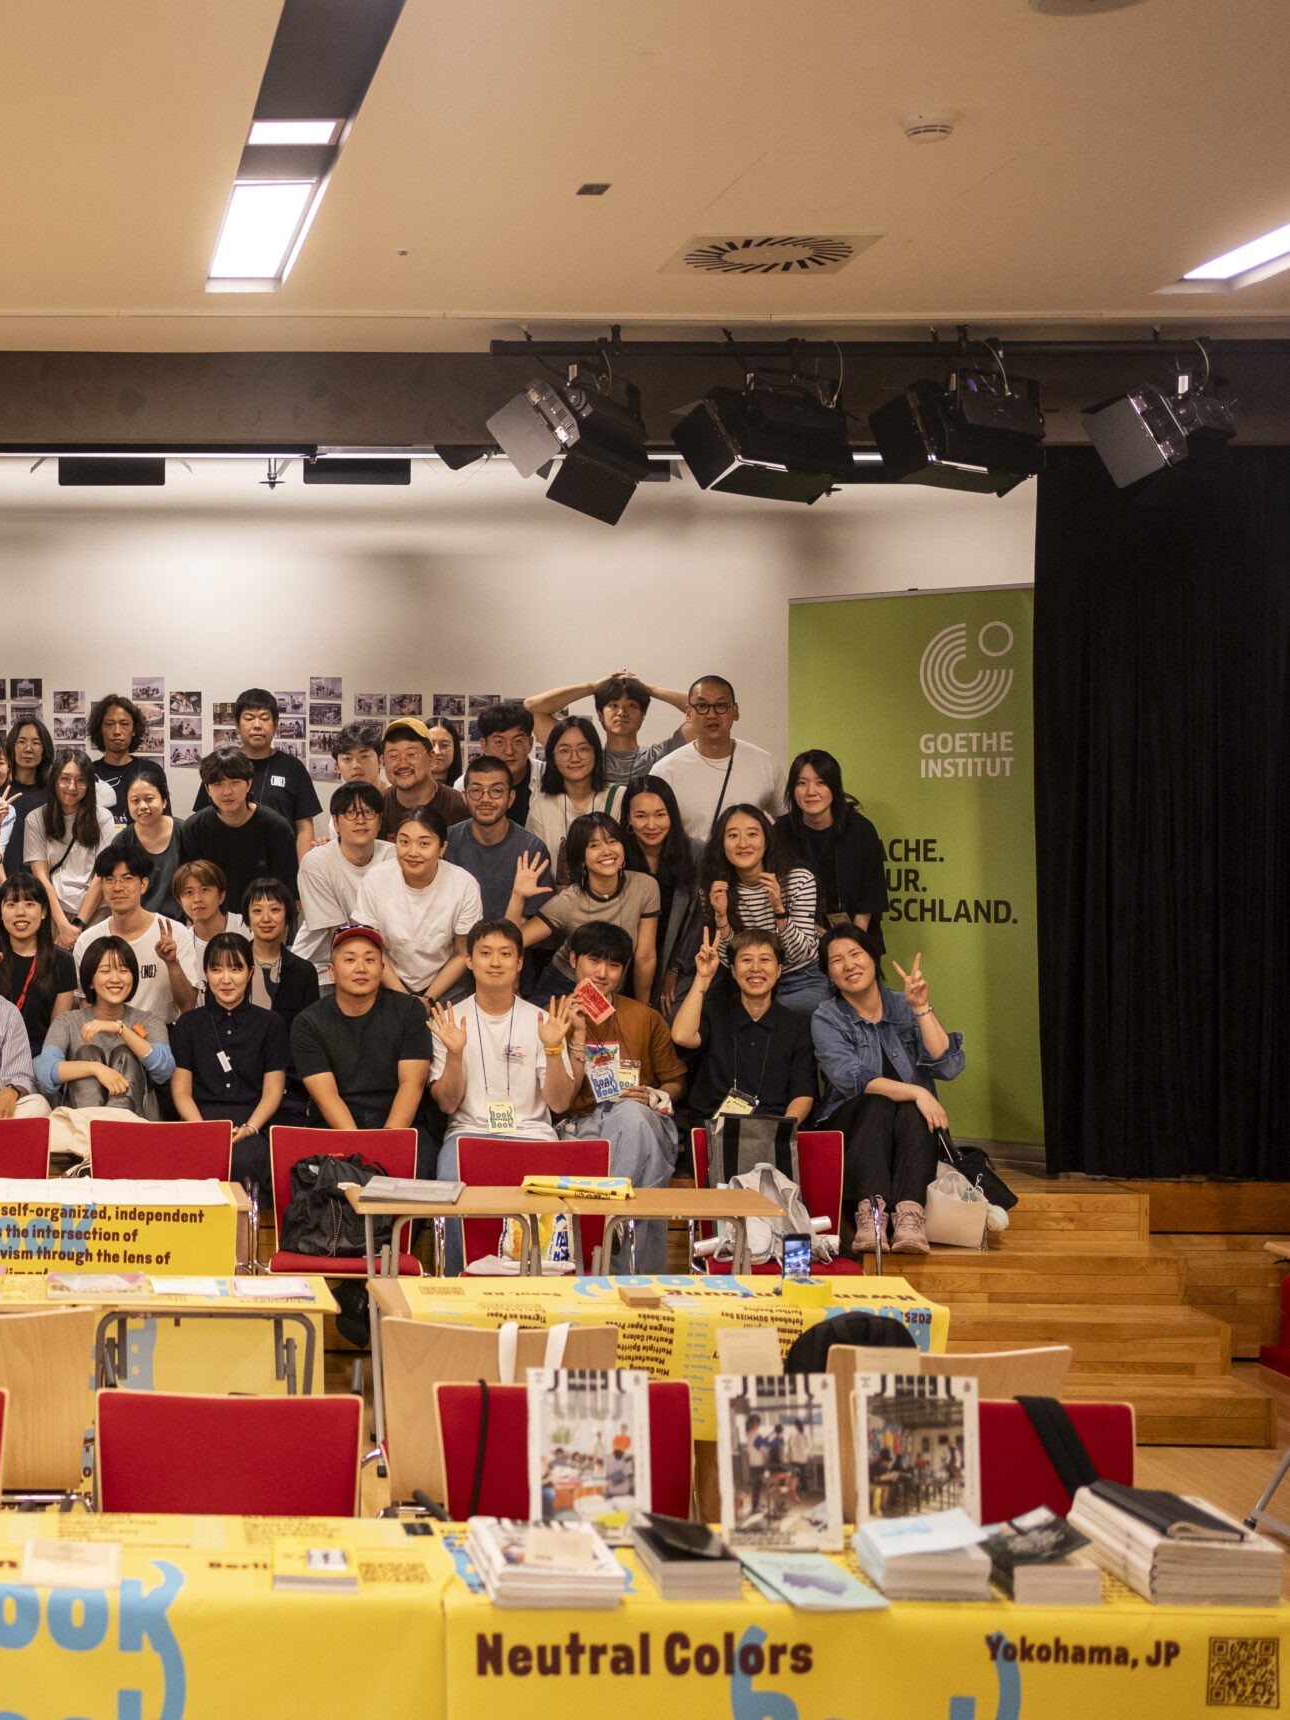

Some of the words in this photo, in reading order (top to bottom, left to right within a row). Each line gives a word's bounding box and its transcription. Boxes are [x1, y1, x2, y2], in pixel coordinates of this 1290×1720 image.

[919, 731, 1014, 754] GOETHE
[920, 757, 1014, 778] INSTITUT
[888, 898, 1018, 925] SCHLAND.
[490, 1110, 513, 1119] Book
[491, 1120, 514, 1129] Book
[1, 1203, 112, 1222] self-organized,
[115, 1207, 205, 1226] independent
[6, 1224, 29, 1239] the
[32, 1225, 120, 1242] intersection
[123, 1228, 139, 1242] of
[36, 1247, 93, 1266] through
[96, 1249, 120, 1263] the
[123, 1250, 153, 1264] lens
[155, 1251, 171, 1265] of
[486, 1311, 508, 1321] Paper
[519, 1313, 547, 1324] Tigress
[721, 1311, 735, 1320] Day
[736, 1313, 768, 1323] DUMMIES
[770, 1315, 804, 1327] Fotobook
[900, 1311, 933, 1325] 2025.
[627, 1321, 648, 1332] Paper
[649, 1323, 675, 1335] Ningen
[622, 1333, 645, 1342] Colors
[646, 1335, 674, 1346] Neutral
[617, 1342, 641, 1353] Spirits
[642, 1344, 673, 1357] Multiple
[617, 1354, 666, 1366] Manufacturin
[656, 1367, 670, 1377] Min
[475, 1631, 650, 1677] Neutral
[663, 1631, 814, 1676] Colors
[984, 1634, 1139, 1671] Yokohama,
[1146, 1640, 1181, 1669] JP
